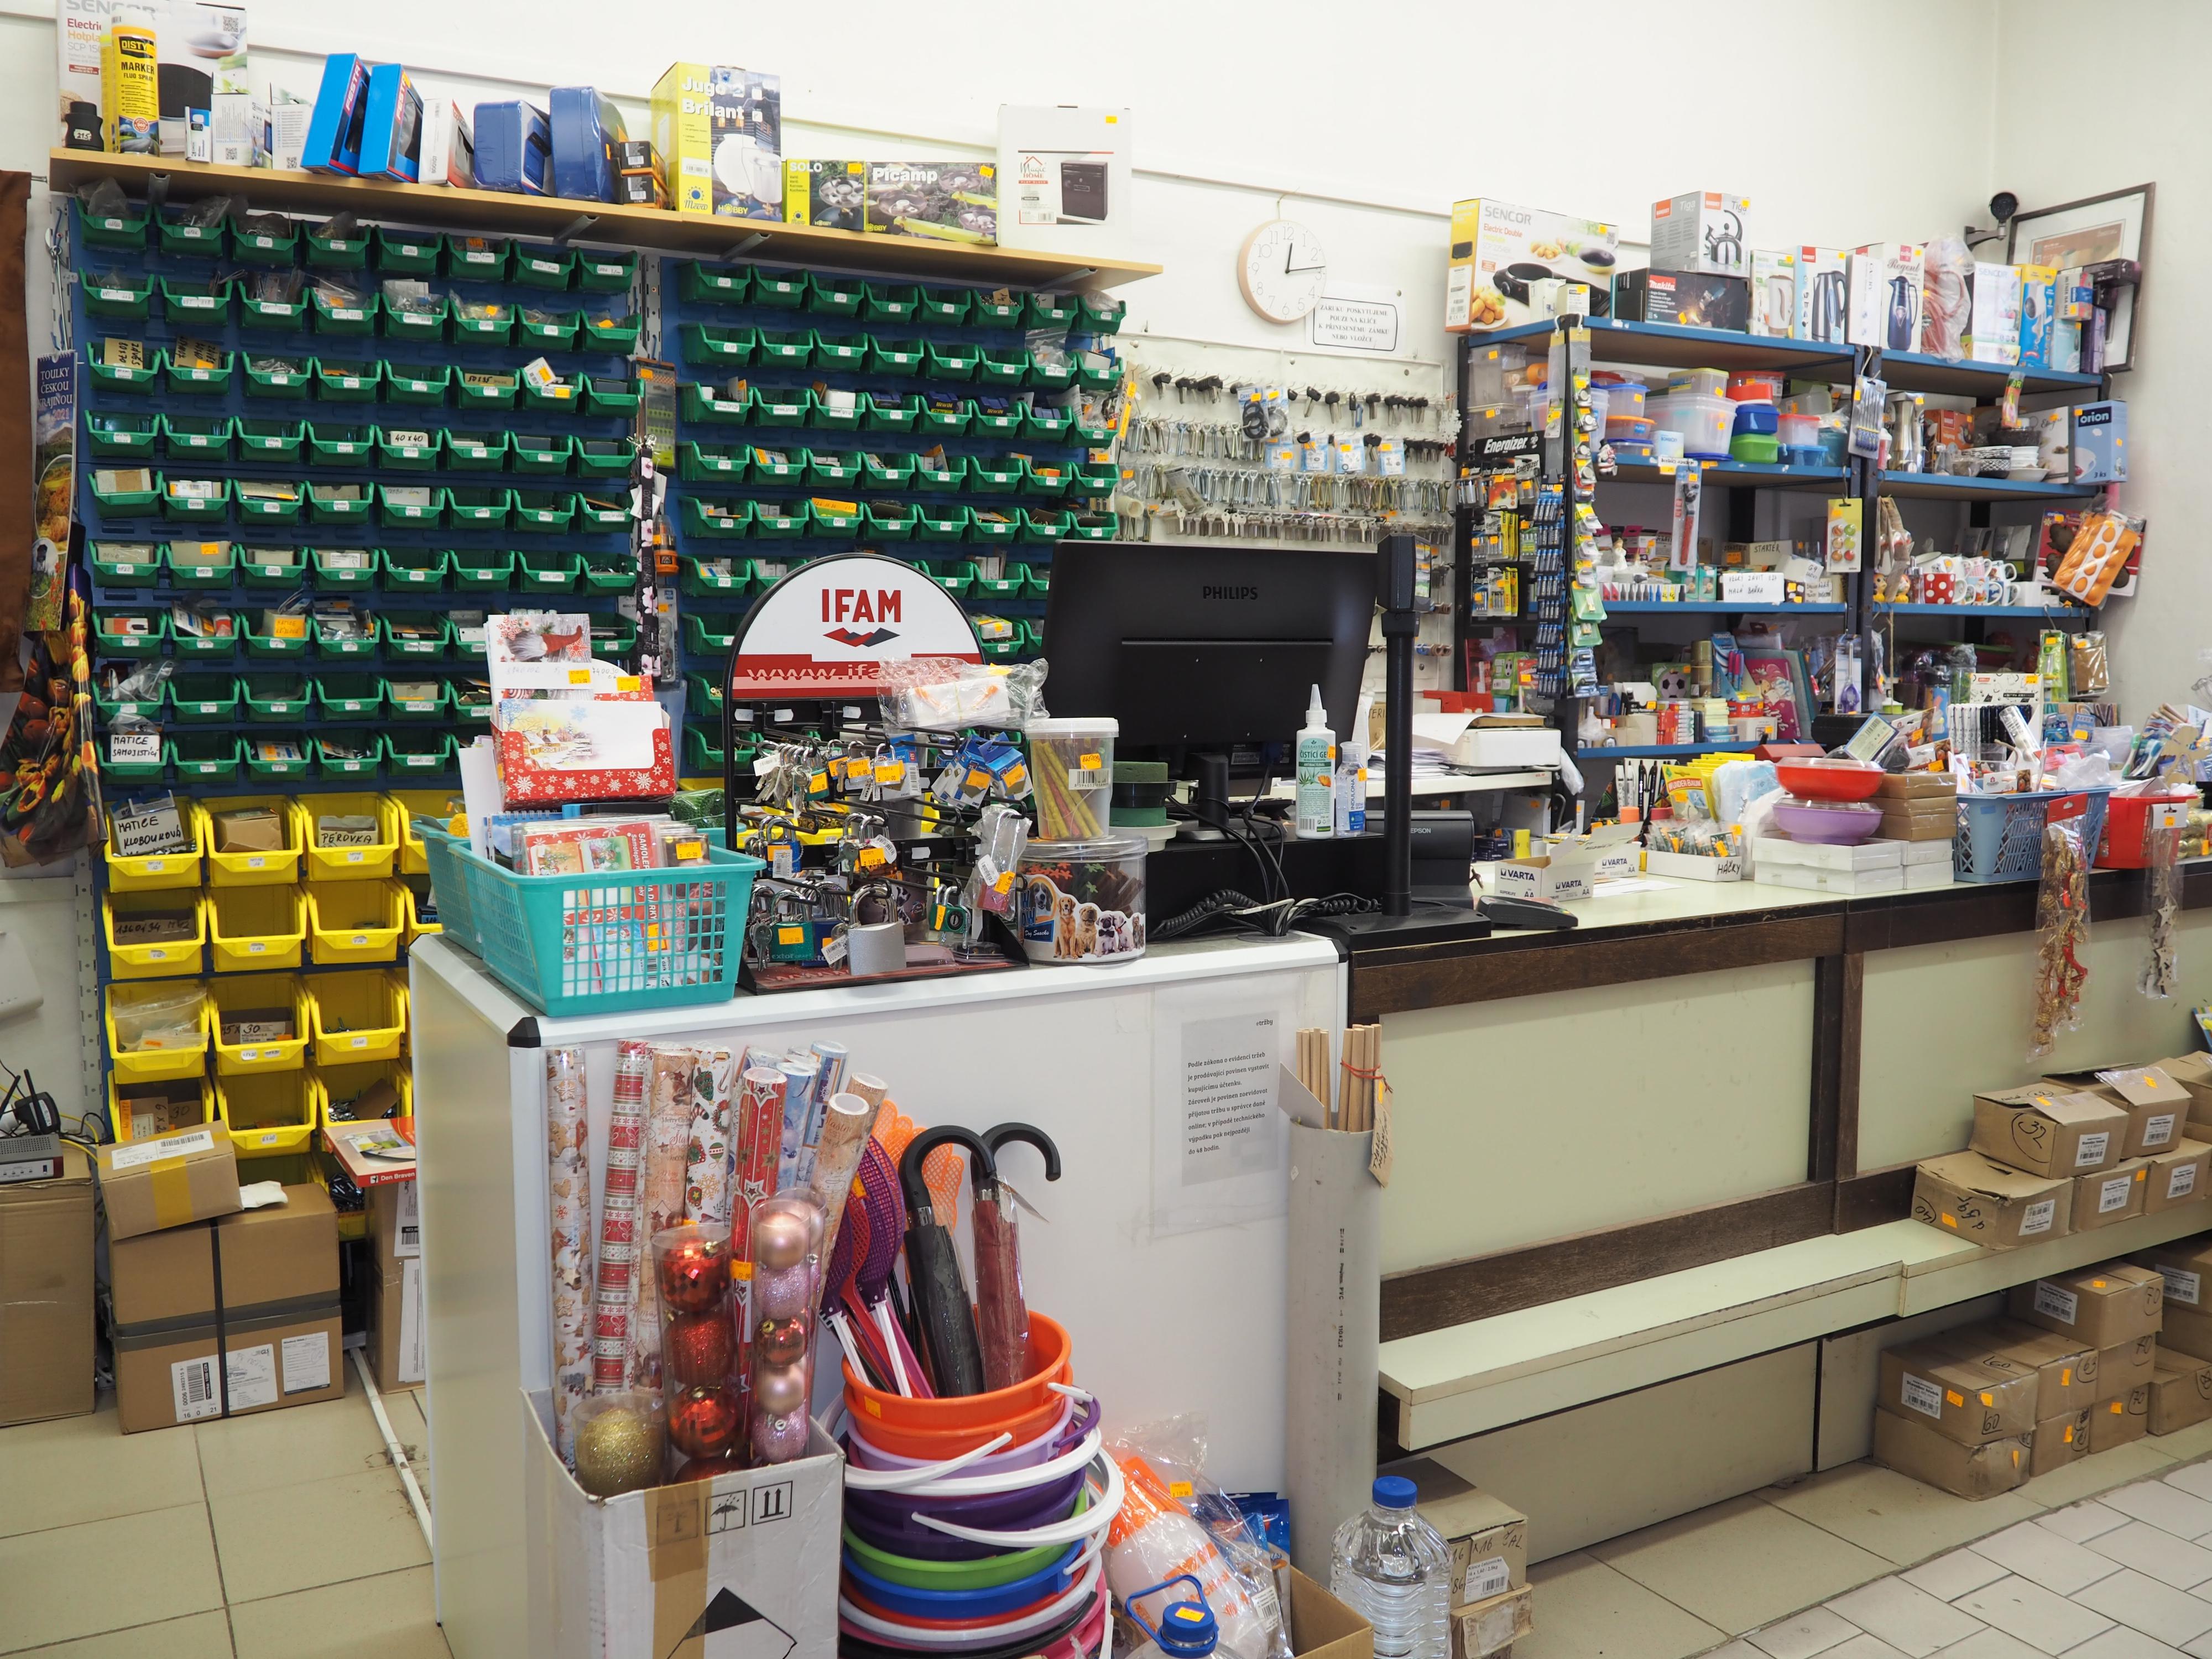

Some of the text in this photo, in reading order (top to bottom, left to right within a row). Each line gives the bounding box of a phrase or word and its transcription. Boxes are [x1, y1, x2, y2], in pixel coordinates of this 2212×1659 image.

[67, 30, 100, 43] Hotpla
[121, 40, 147, 50] DISTY
[121, 61, 154, 75] MARKER
[345, 64, 361, 112] FESTA
[682, 76, 728, 97] Jugo
[397, 75, 408, 119] FESTA
[682, 98, 745, 120] Brilant
[789, 162, 823, 173] SOLO
[1020, 162, 1046, 174] Magic
[873, 167, 938, 184] Picamp
[717, 203, 748, 215] HOBBY
[1679, 199, 1696, 211] Tiga
[1731, 200, 1747, 213] Tiga
[1484, 205, 1532, 226] SENCOR
[867, 223, 887, 232] OBBY
[1283, 226, 1294, 240] 12
[1484, 223, 1523, 238] Electric Double
[1311, 248, 1318, 260] 2
[1887, 258, 1921, 273] Regent
[1308, 286, 1316, 298] 4
[1269, 296, 1275, 309] 7
[1282, 302, 1290, 315] 6
[1298, 298, 1305, 310] 5
[1347, 306, 1389, 316] POSKYTUJEME
[1350, 334, 1373, 342] VLOŽCE
[40, 367, 70, 380] TOULKY
[40, 380, 70, 394] ČESKOU
[37, 394, 72, 408] KRAJINOU
[51, 408, 70, 420] 2021
[2079, 411, 2109, 424] orion
[394, 434, 406, 442] 40
[1484, 436, 1527, 454] Energizer
[1492, 466, 1516, 475] Energizer
[1202, 586, 1259, 601] PHILIPS
[821, 588, 901, 623] IFAM
[747, 663, 881, 682] www.ifa
[113, 737, 149, 745] MATICE
[1300, 750, 1318, 759] ČISTÍCÍ
[1668, 778, 1702, 791] WUNDER-BAUM
[118, 817, 159, 833] MATICE
[124, 826, 182, 849] KLOBOUKOVÁ
[321, 832, 373, 844] PÉROVKA
[632, 834, 640, 865] Samolepky
[638, 833, 650, 870] SAMOLEP
[1717, 860, 1741, 875] HÁČKY
[1507, 869, 1535, 881] VARTA
[1561, 879, 1582, 888] VARTA
[243, 1023, 260, 1034] 30
[1229, 1054, 1250, 1062] evidenci
[1194, 1070, 1224, 1081] prodávající
[1225, 1067, 1246, 1076] povinen
[1248, 1064, 1269, 1073] vystavit
[1188, 1084, 1218, 1093] kupujícímu
[1217, 1093, 1238, 1101] povinen
[1239, 1088, 1267, 1097] zaevidovat
[1188, 1109, 1210, 1118] přijatou
[1212, 1118, 1233, 1127] případě
[1234, 1113, 1265, 1123] technického
[1188, 1134, 1212, 1143] výpadku
[1224, 1127, 1250, 1136] nejpozději
[2017, 1119, 2046, 1149] 32
[394, 1171, 415, 1180] Braven
